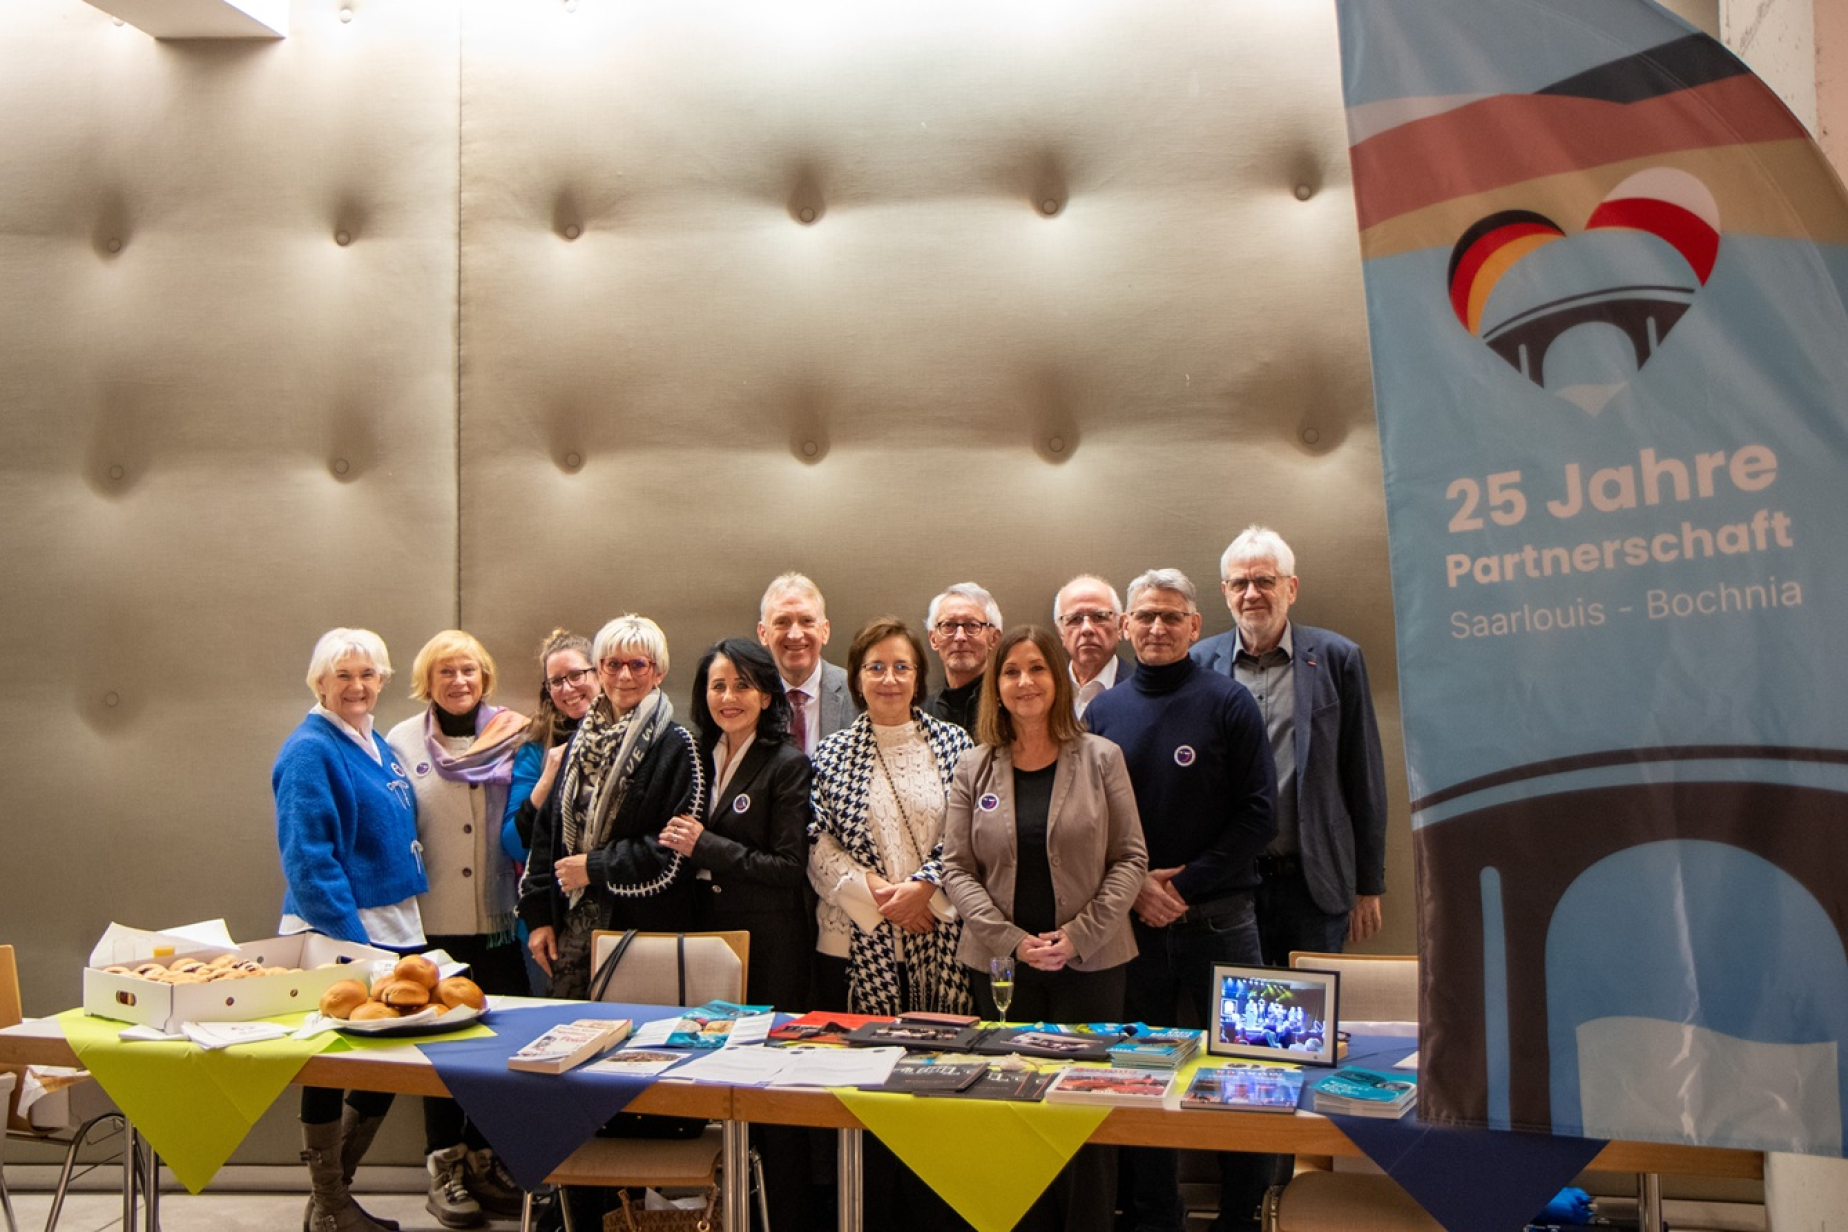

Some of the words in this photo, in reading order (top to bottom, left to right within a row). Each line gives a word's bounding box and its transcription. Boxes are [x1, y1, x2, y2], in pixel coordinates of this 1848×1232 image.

[1445, 470, 1527, 533] 25
[1546, 443, 1778, 519] Jahre
[1445, 509, 1794, 588] Partnerschaft
[1450, 598, 1606, 640] Saarlouis
[1646, 576, 1804, 620] Bochnia
